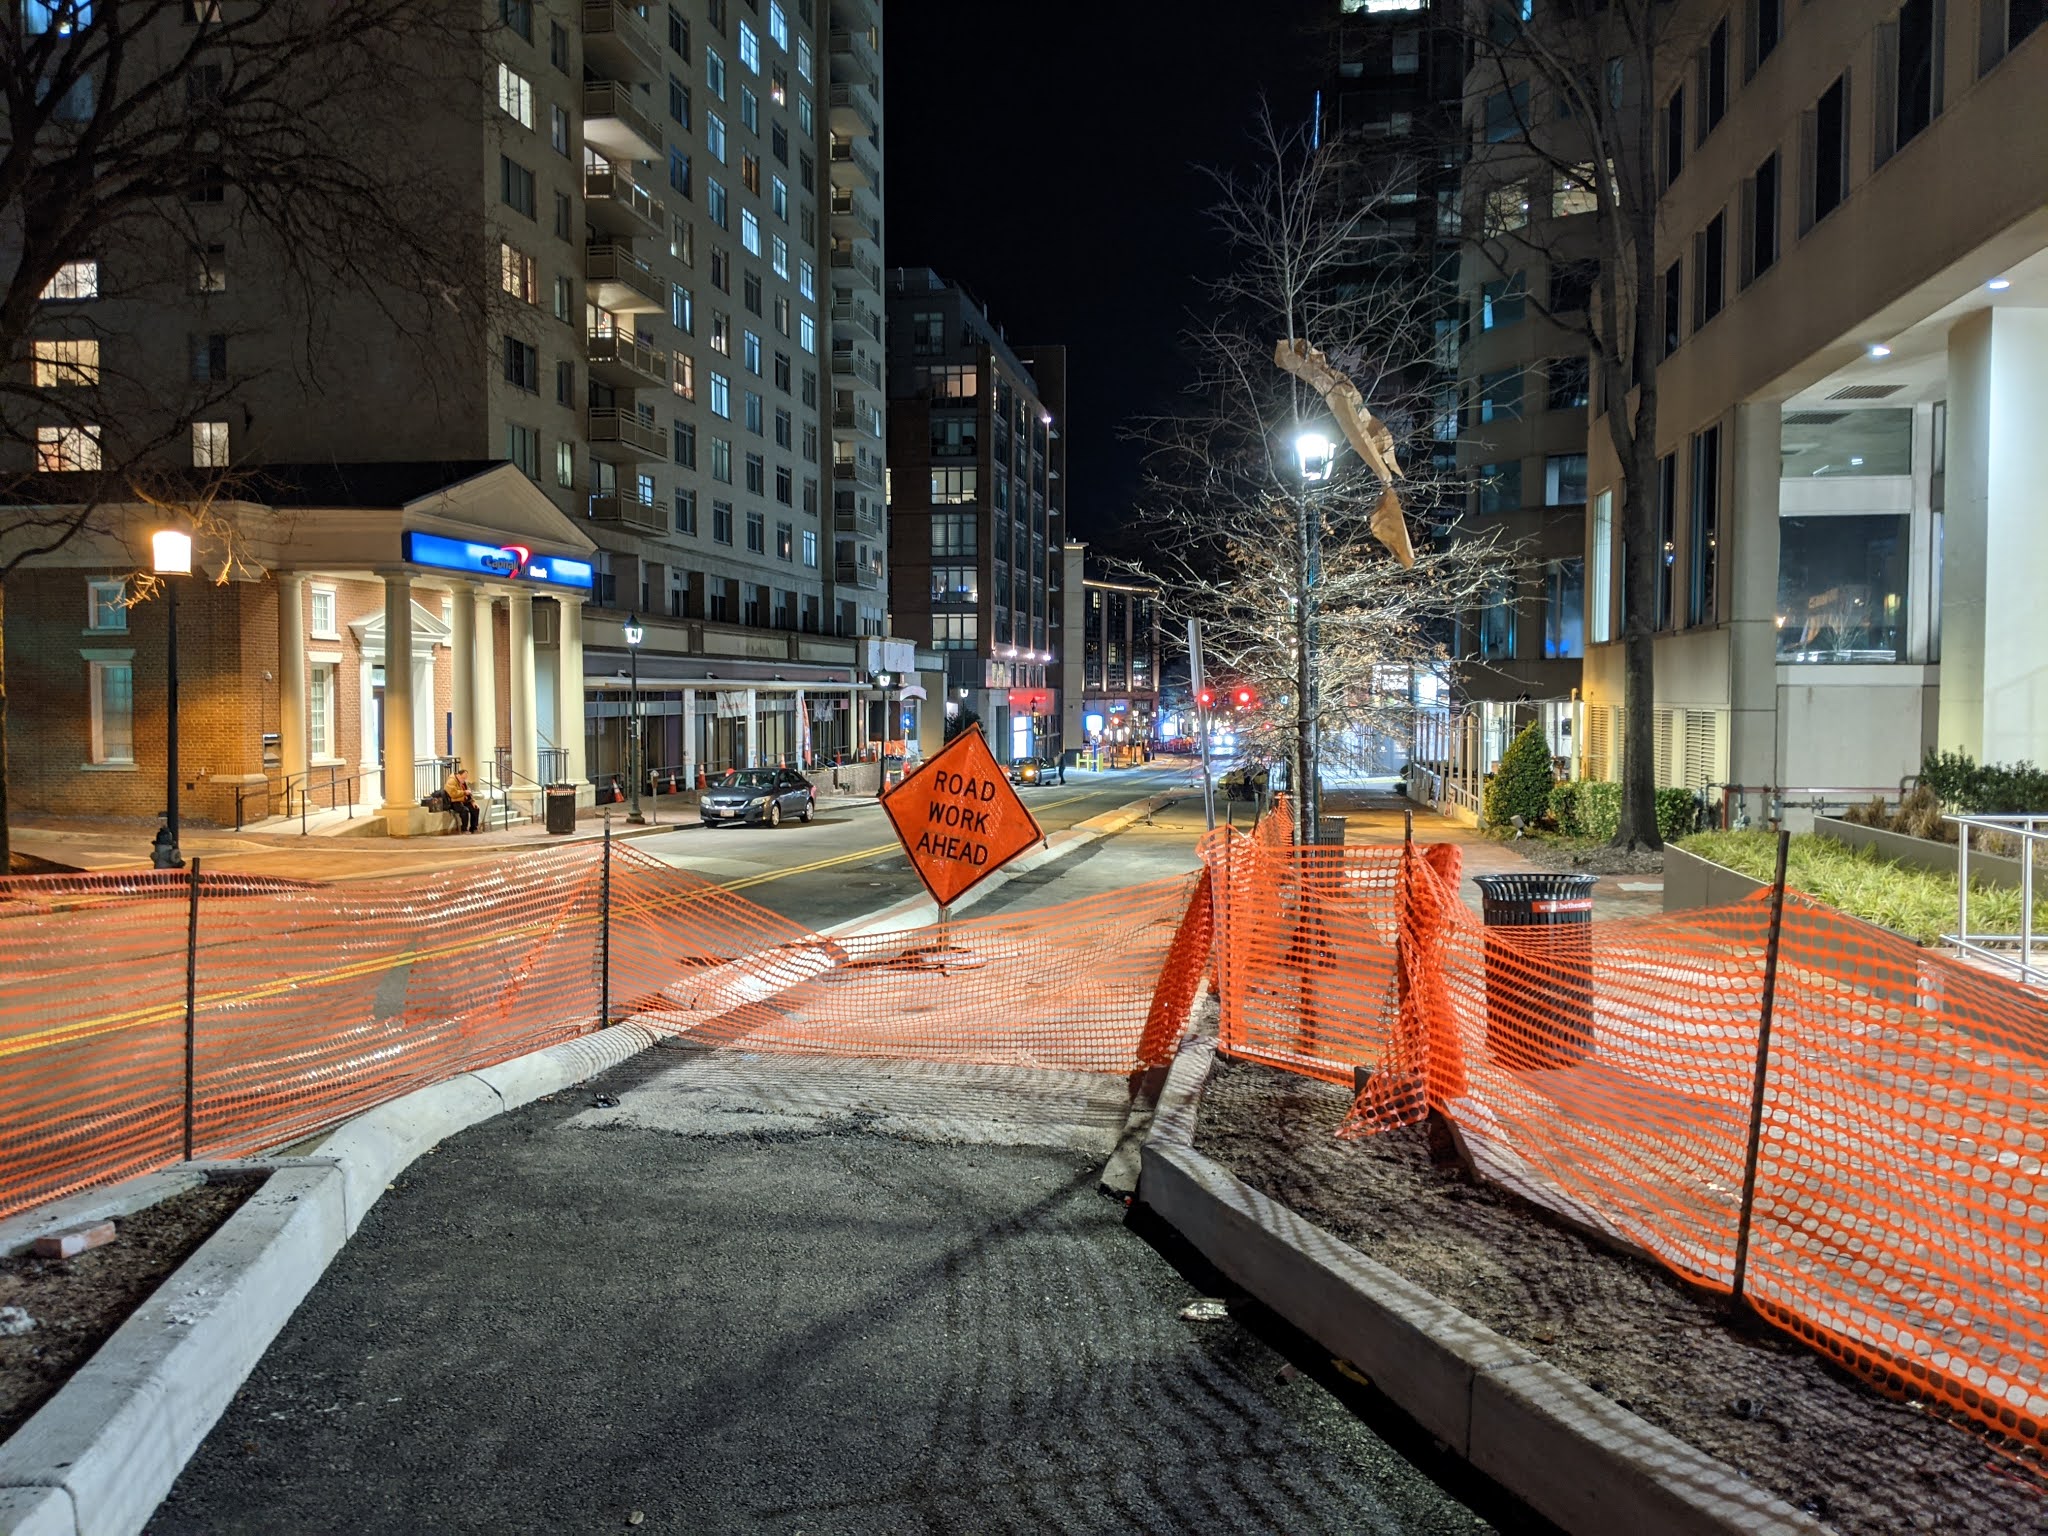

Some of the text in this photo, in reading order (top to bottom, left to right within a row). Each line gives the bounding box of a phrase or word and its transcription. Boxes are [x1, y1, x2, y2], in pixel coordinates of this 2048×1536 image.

[933, 770, 996, 802] ROAD
[928, 801, 990, 834] WORK
[916, 832, 988, 866] AHEAD
